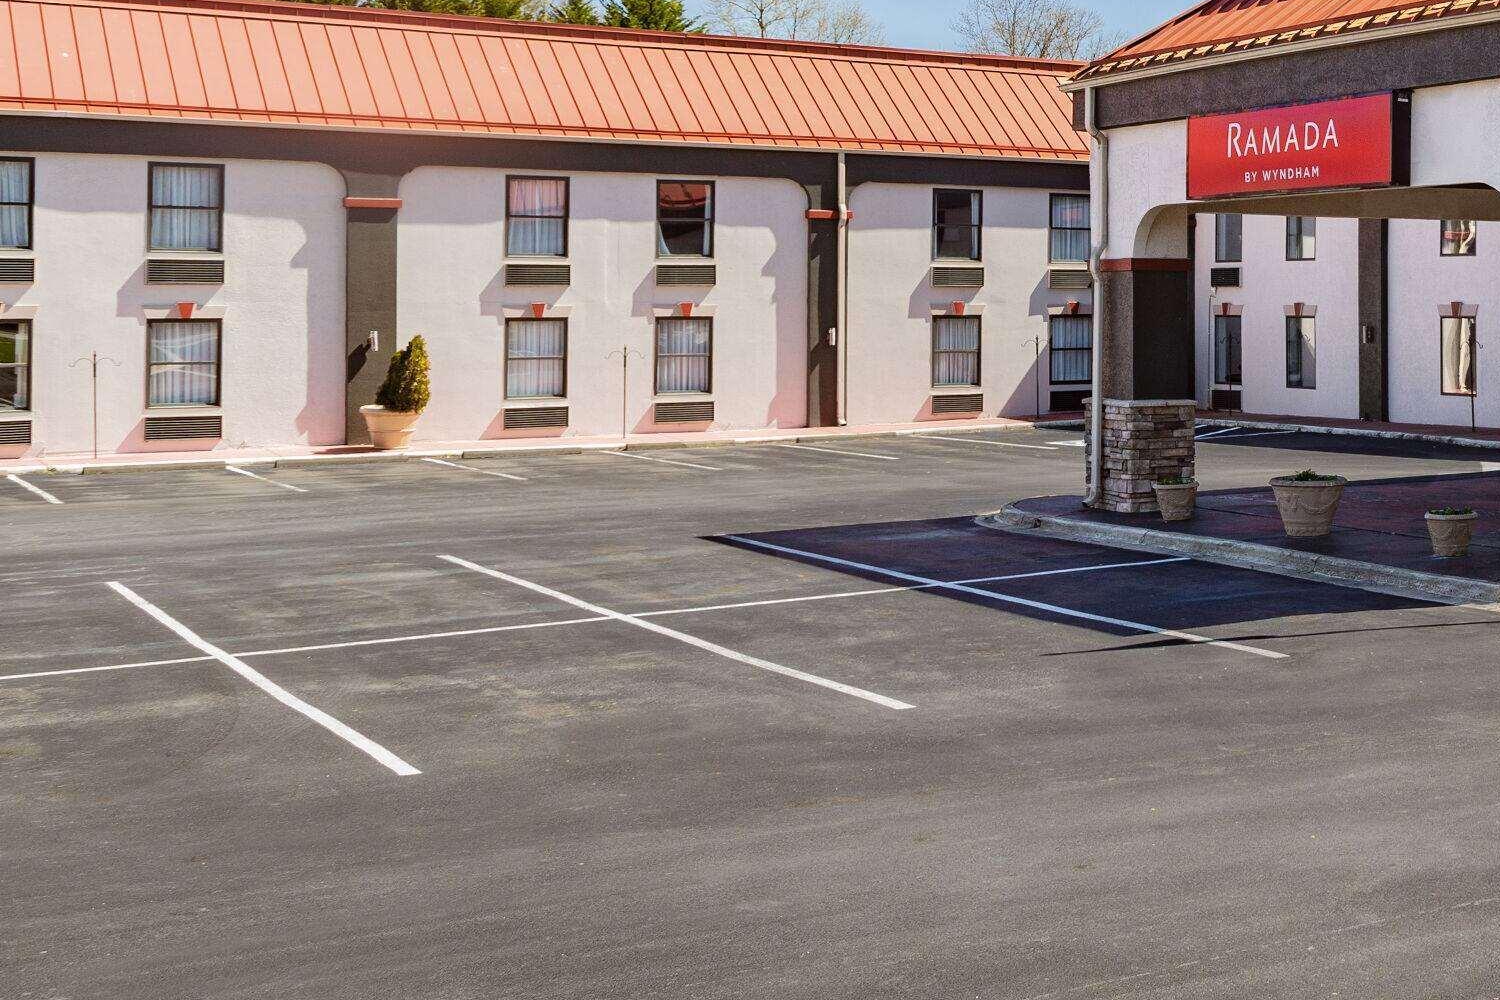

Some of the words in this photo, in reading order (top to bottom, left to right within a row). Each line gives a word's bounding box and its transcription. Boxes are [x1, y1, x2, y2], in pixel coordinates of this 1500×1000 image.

[1227, 118, 1339, 158] RAMADA
[1244, 171, 1258, 183] BY
[1262, 165, 1320, 181] WYNDHAM
